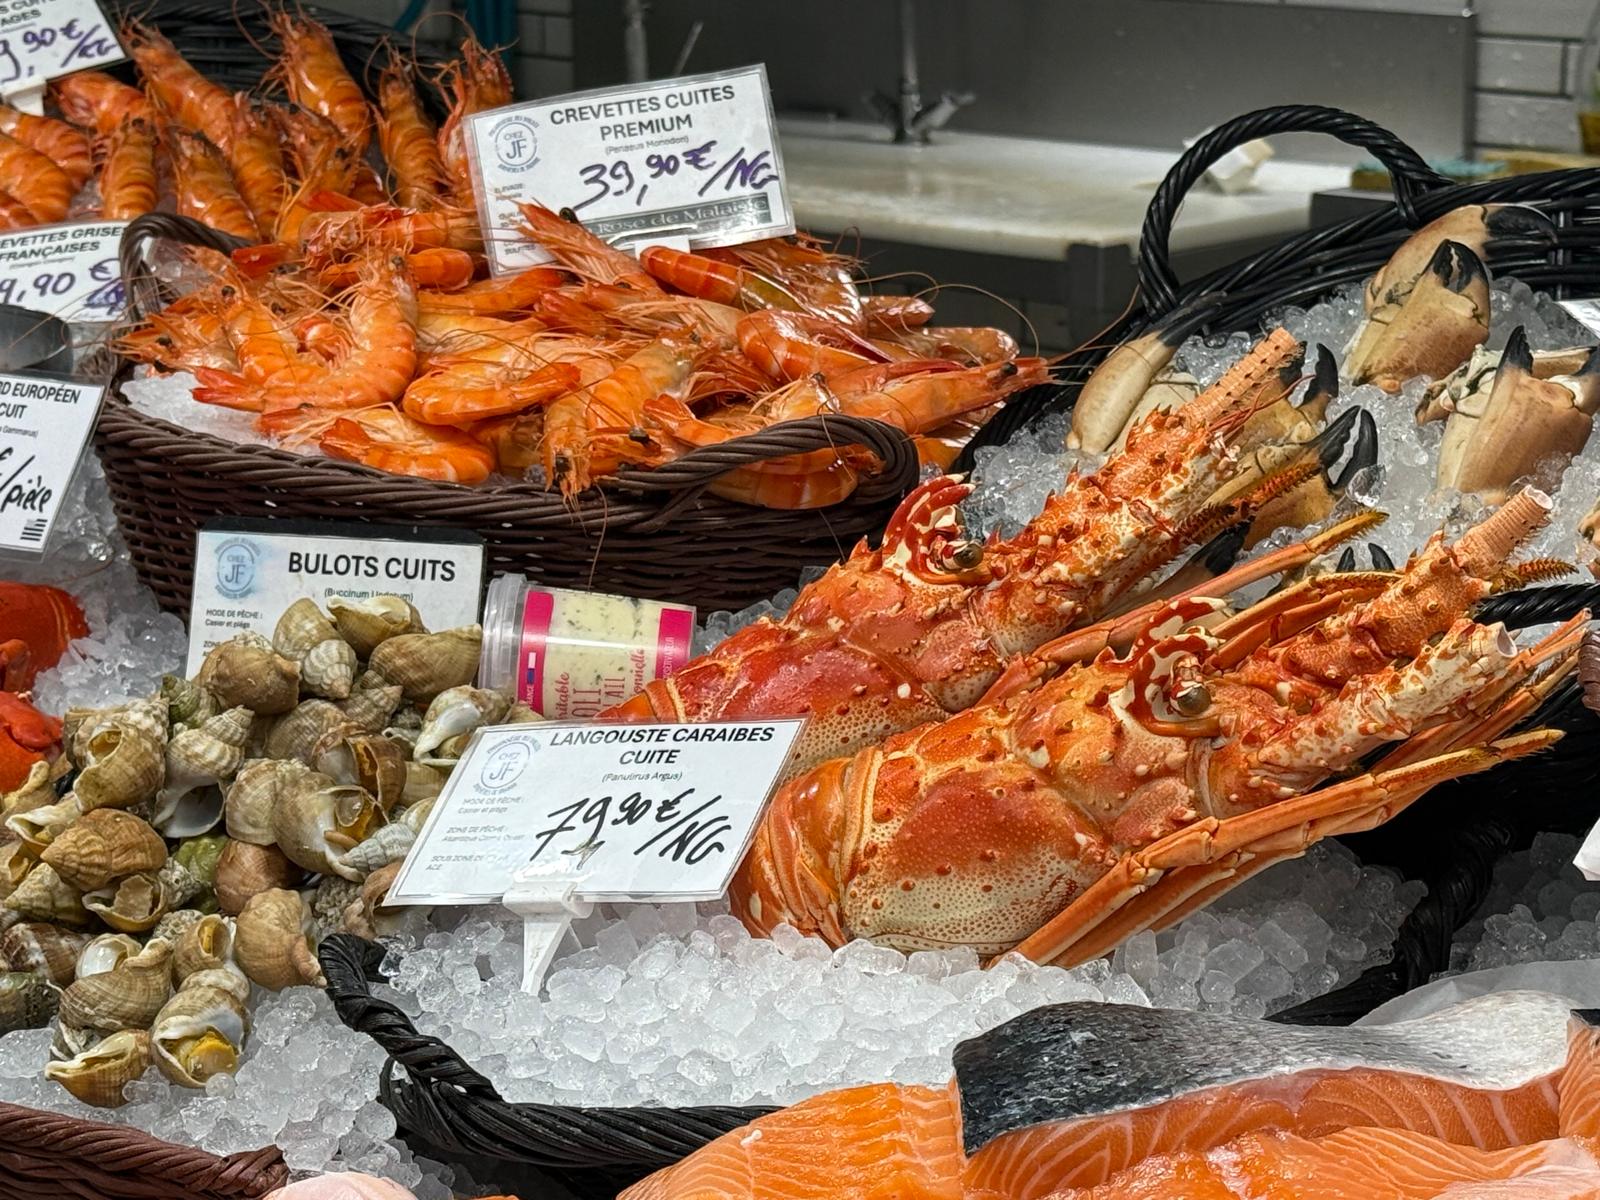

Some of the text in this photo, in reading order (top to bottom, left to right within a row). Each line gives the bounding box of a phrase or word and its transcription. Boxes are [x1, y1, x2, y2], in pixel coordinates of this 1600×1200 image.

[550, 85, 735, 125] CREVETTES CUITES
[600, 114, 693, 141] PREMIUM
[506, 138, 527, 159] JF
[651, 213, 679, 226] de
[72, 226, 122, 240] GRISE
[12, 383, 81, 404] EUROPÉEN
[224, 564, 247, 584] JF
[289, 552, 456, 582] BULOTS CUITS
[550, 728, 670, 747] LANGOUSTE
[672, 727, 775, 743] CARAIBES
[619, 749, 681, 765] CUITE
[489, 760, 519, 780] JF
